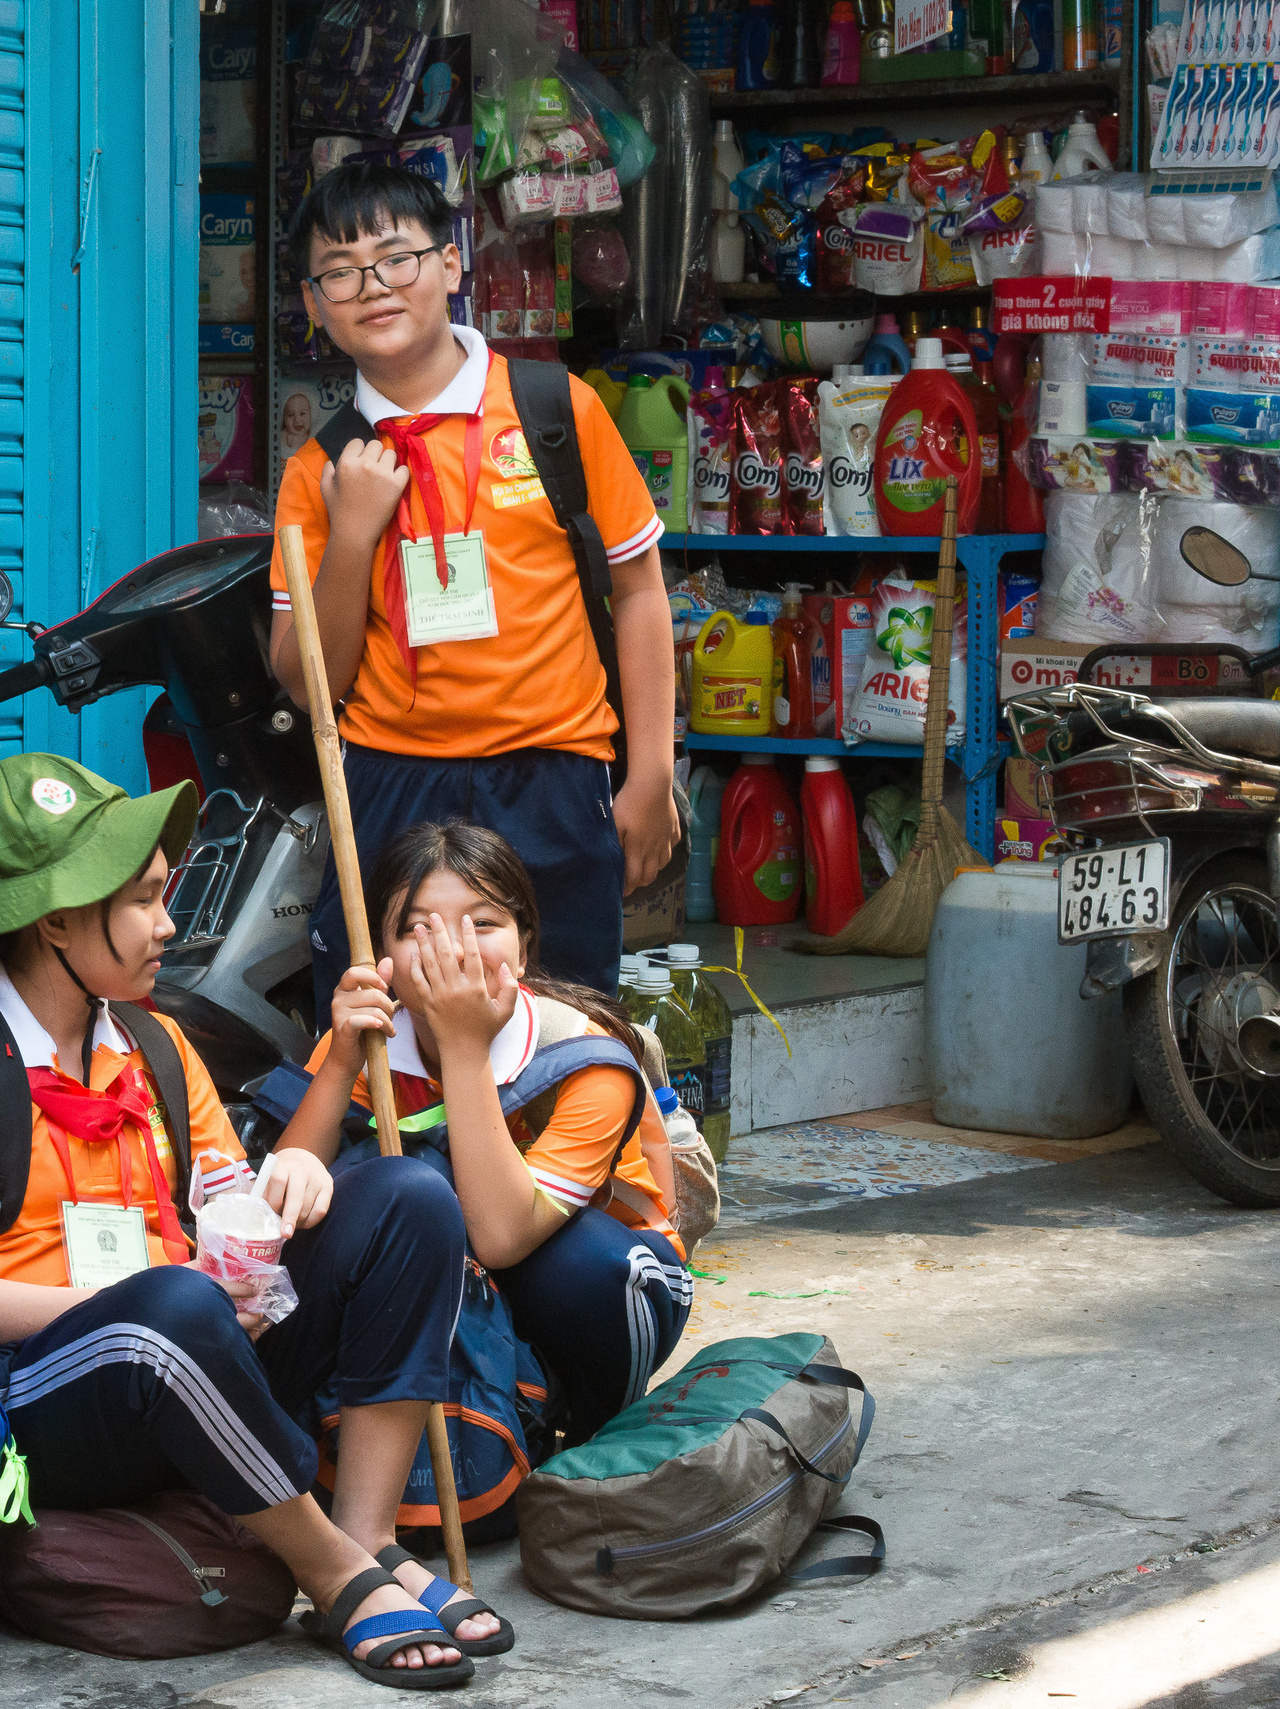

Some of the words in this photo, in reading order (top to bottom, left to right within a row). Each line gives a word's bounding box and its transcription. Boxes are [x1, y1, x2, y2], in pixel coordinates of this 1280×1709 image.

[201, 213, 253, 240] Caryn
[982, 227, 1035, 250] ARIE
[854, 243, 912, 263] ARIEL
[1016, 295, 1040, 309] thêm
[1042, 285, 1056, 308] 2
[1001, 311, 1022, 331] giá
[1025, 312, 1070, 330] không
[230, 331, 255, 350] Cary
[502, 494, 521, 506] QUẬN
[1011, 659, 1122, 686] Omahi
[1046, 657, 1065, 666] khoai
[1066, 658, 1078, 668] tây
[1178, 659, 1209, 680] Bò
[863, 671, 930, 702] ARIE
[714, 688, 747, 711] NET
[878, 702, 902, 717] Downy
[1073, 848, 1147, 892] 59-L1
[273, 903, 314, 919] HON
[1064, 887, 1159, 935] 484.63
[677, 1082, 705, 1112] FINA
